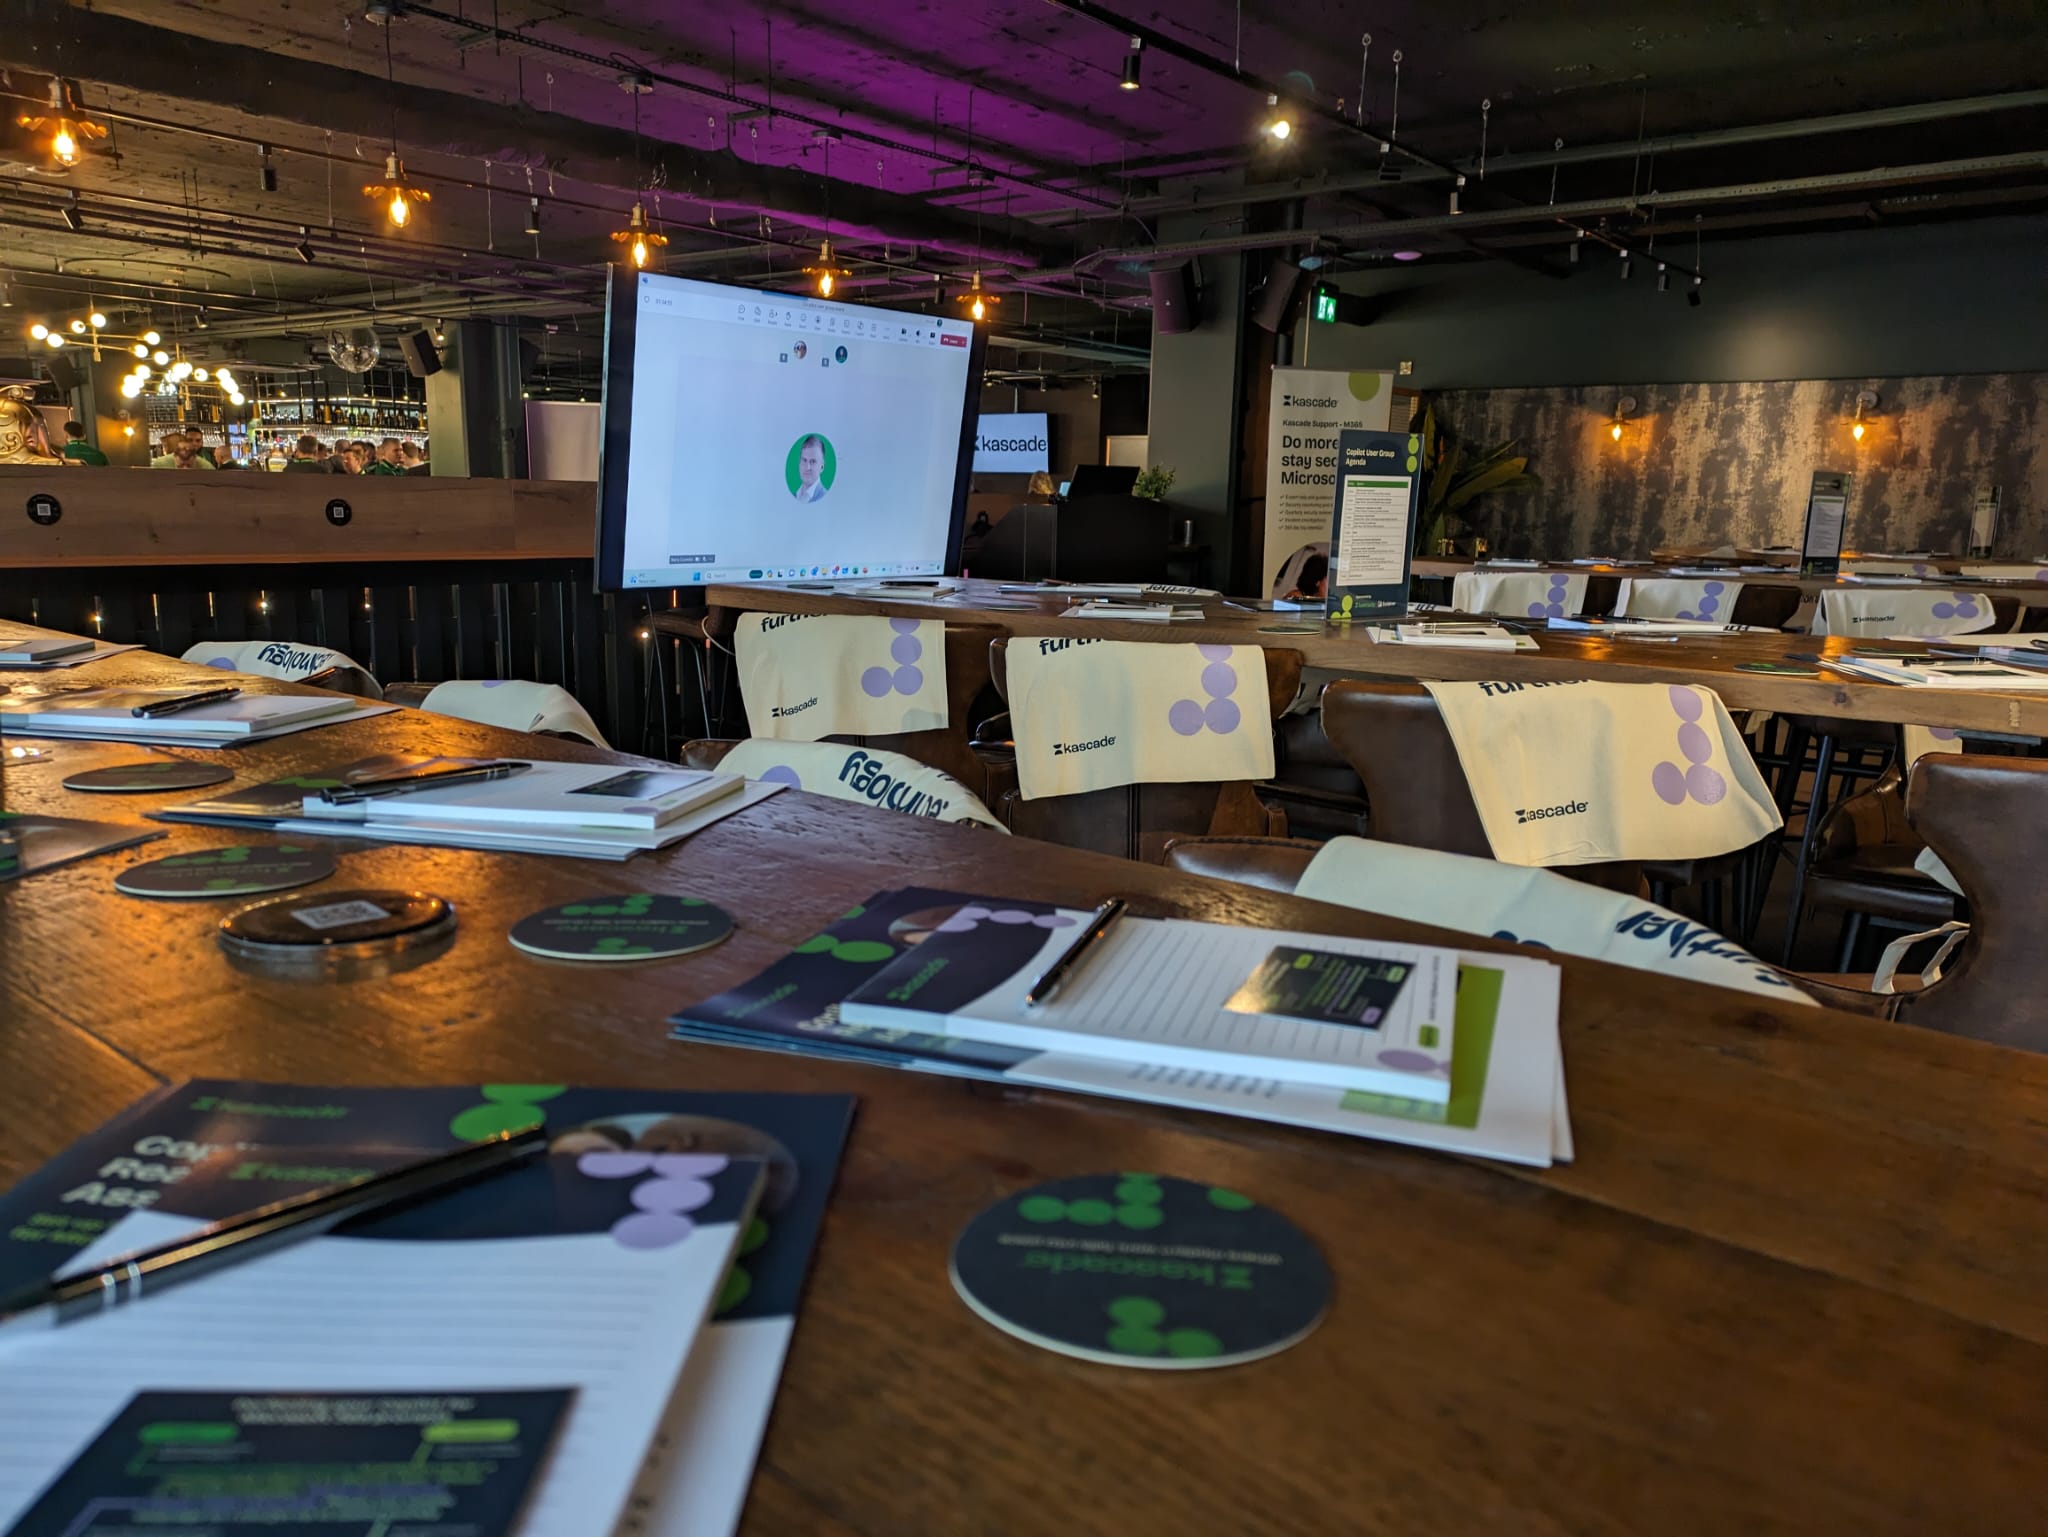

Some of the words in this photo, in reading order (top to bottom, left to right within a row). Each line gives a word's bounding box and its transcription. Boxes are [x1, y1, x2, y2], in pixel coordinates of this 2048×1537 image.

[1292, 396, 1338, 408] kascade
[1282, 420, 1311, 428] Kascade
[1312, 421, 1338, 430] Support
[982, 435, 1047, 451] kascade
[1282, 435, 1302, 449] Do
[1305, 438, 1340, 450] more
[1282, 454, 1312, 470] stay
[1315, 456, 1337, 467] sec
[1281, 471, 1336, 485] Microso
[780, 697, 818, 716] kascade
[1063, 736, 1116, 754] kascade
